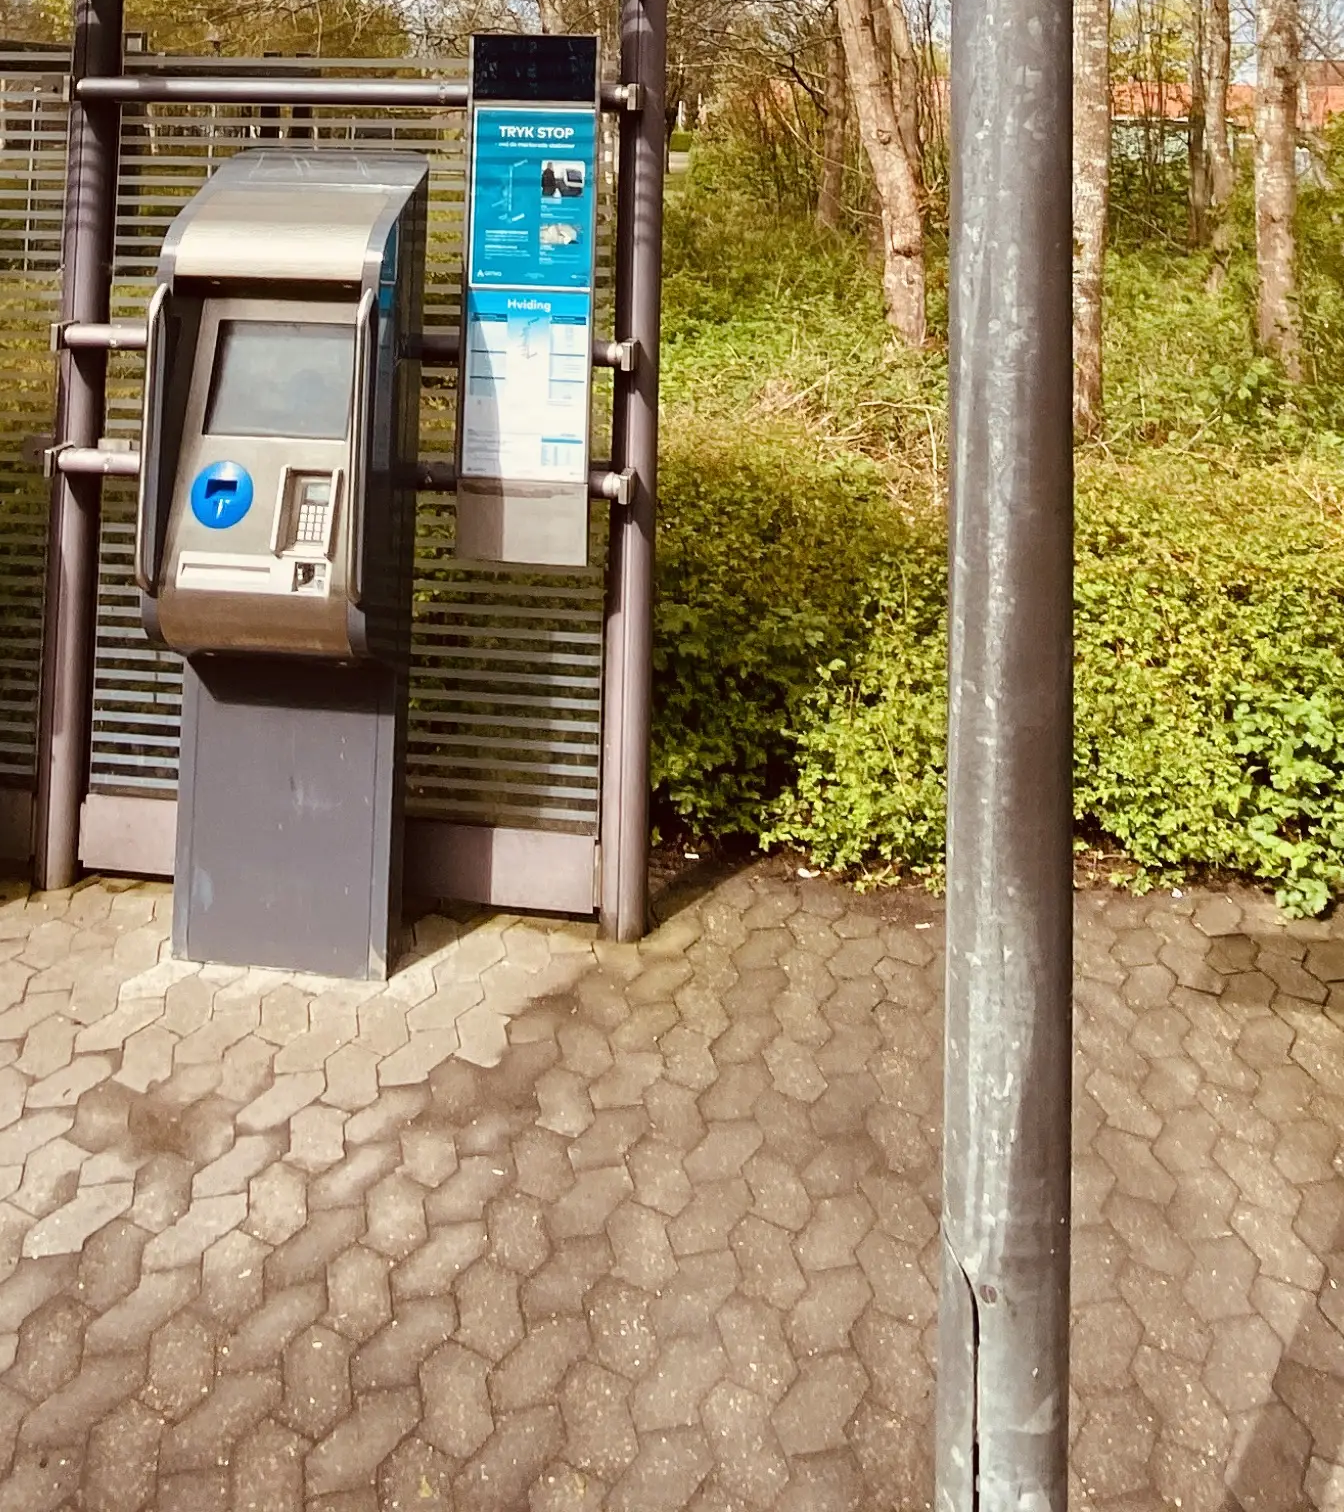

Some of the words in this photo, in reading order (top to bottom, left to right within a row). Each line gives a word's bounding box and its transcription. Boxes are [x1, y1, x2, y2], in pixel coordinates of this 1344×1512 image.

[498, 125, 534, 138] TRYK
[537, 126, 575, 139] STOP
[507, 298, 552, 313] Hviding
